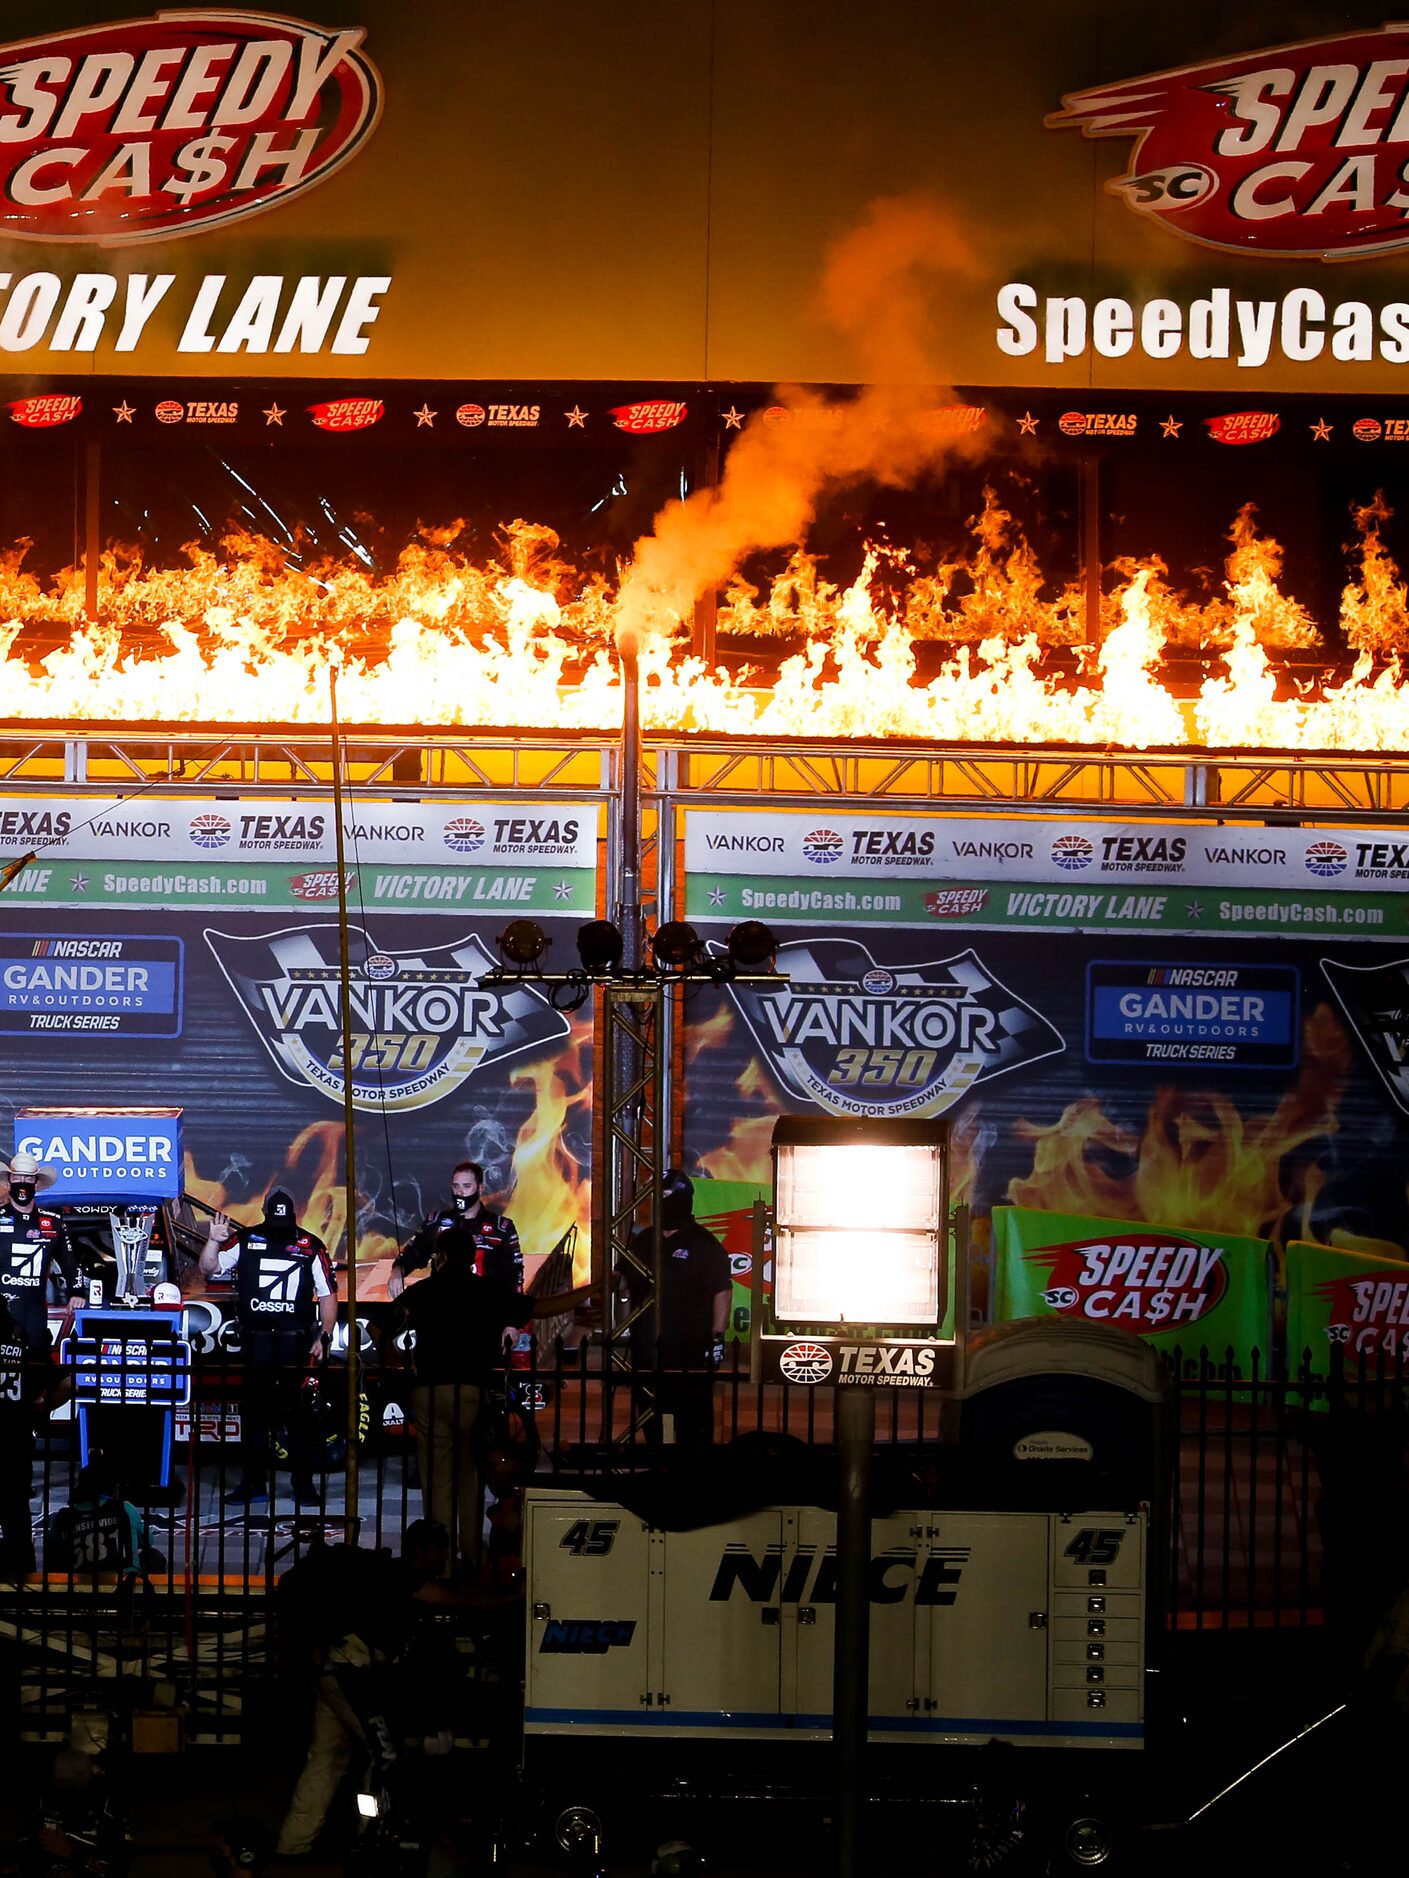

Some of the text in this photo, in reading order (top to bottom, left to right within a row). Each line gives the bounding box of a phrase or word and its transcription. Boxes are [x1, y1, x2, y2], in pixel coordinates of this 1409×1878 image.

[1124, 172, 1202, 201] SC
[177, 275, 392, 355] LANE
[26, 396, 81, 413] SPEEDY
[187, 402, 239, 416] TEXAS
[488, 405, 540, 420] TEXAS
[629, 402, 686, 419] SPEEDY
[1086, 414, 1137, 429] TEXAS
[1224, 413, 1278, 431] SPEEDY
[90, 820, 171, 837] VANKOR
[241, 816, 324, 839] TEXAS
[344, 824, 424, 842] VANKOR
[493, 819, 579, 844] TEXAS
[19, 837, 69, 846] SPEEDWAY
[240, 840, 323, 850] MOTOR SPEEDWAY
[493, 845, 577, 854] MOTOR SPEEDWAY
[706, 834, 784, 852] VANKOR
[852, 831, 935, 856] TEXAS
[953, 841, 1033, 858] VANKOR
[1102, 837, 1186, 863] TEXAS
[851, 856, 933, 866] MOTOR SPEEDWAY
[1205, 847, 1286, 865] VANKOR
[1101, 862, 1185, 872] MOTOR SPEEDWAY
[104, 873, 266, 895] SpeedyCash.com
[374, 876, 536, 900] VICTORY LANE
[743, 889, 901, 912] SpeedyCash.com
[937, 889, 987, 905] SPEEDY
[1007, 893, 1167, 920] VICTORY LANE
[1219, 901, 1383, 924] SpeedyCash.com
[53, 941, 123, 958] NASCAR
[4, 965, 149, 991] GANDER
[1169, 968, 1238, 987] NASCAR
[262, 987, 502, 1033] VANKOR
[1119, 993, 1265, 1021] GANDER
[30, 1014, 120, 1030] TRUCK SERIES
[763, 1000, 996, 1049] VANKOR
[328, 1033, 439, 1072] 350
[1146, 1044, 1236, 1059] TRUCK SERIES
[828, 1049, 937, 1087] 350
[306, 1059, 451, 1099] TEXAS SPEEDWAY
[807, 1075, 948, 1116] TEXAS MOTOR SPEEDWAY
[18, 1136, 173, 1163] GANDER
[62, 1167, 168, 1178] OUTDOORS
[73, 1205, 118, 1214] ROWDY
[1075, 1244, 1224, 1290] SPEEDY
[1, 1273, 41, 1288] Cessna
[251, 1298, 295, 1313] Cessna
[1042, 1290, 1074, 1306] SC
[839, 1346, 935, 1375] TEXAS
[839, 1374, 930, 1387] MOTOR SPEEDWAY
[559, 1519, 621, 1557] 45
[1063, 1528, 1125, 1566] 45
